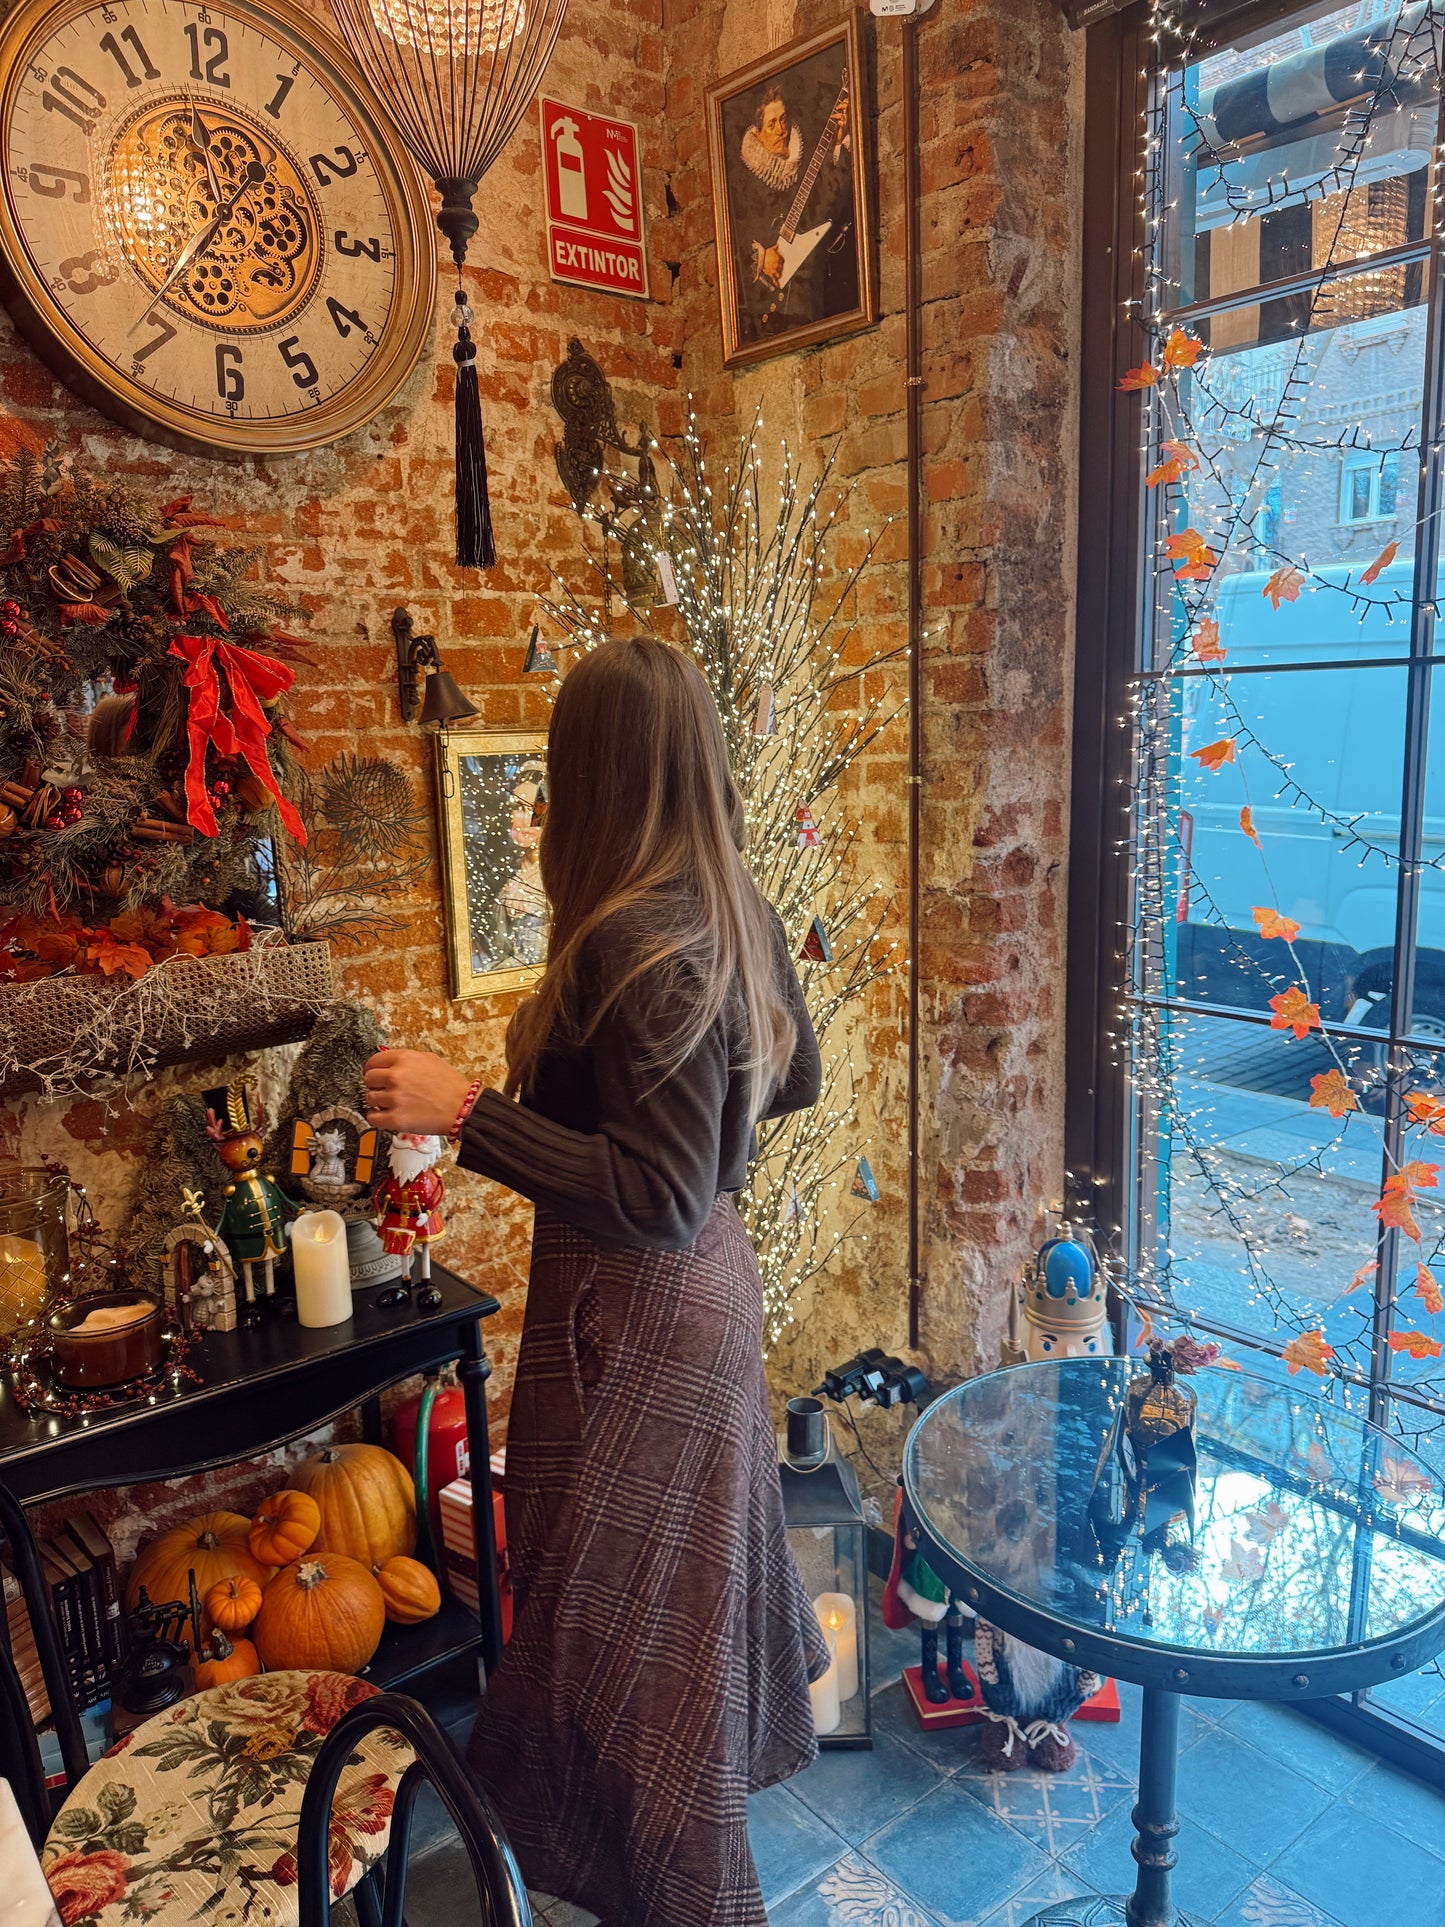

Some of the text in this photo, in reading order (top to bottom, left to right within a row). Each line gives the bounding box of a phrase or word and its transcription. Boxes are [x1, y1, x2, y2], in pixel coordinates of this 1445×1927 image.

[102, 10, 118, 24] 55
[198, 12, 211, 25] 60
[99, 24, 161, 89] 11
[183, 23, 230, 88] 12
[33, 66, 48, 83] 50
[42, 66, 107, 137] 10
[264, 74, 294, 119] 1
[16, 166, 28, 183] 45
[308, 145, 358, 186] 2
[354, 151, 365, 164] 10
[29, 163, 91, 204] 9
[334, 230, 381, 263] 3
[381, 247, 390, 260] 15
[555, 239, 641, 281] EXTINTOR
[52, 276, 67, 292] 40
[59, 249, 120, 295] 8
[325, 296, 369, 338] 4
[132, 311, 178, 362] 7
[363, 330, 374, 345] 20
[130, 361, 146, 375] 35
[215, 343, 245, 402] 6
[278, 336, 319, 389] 5
[225, 401, 239, 411] 30
[308, 387, 321, 398] 25
